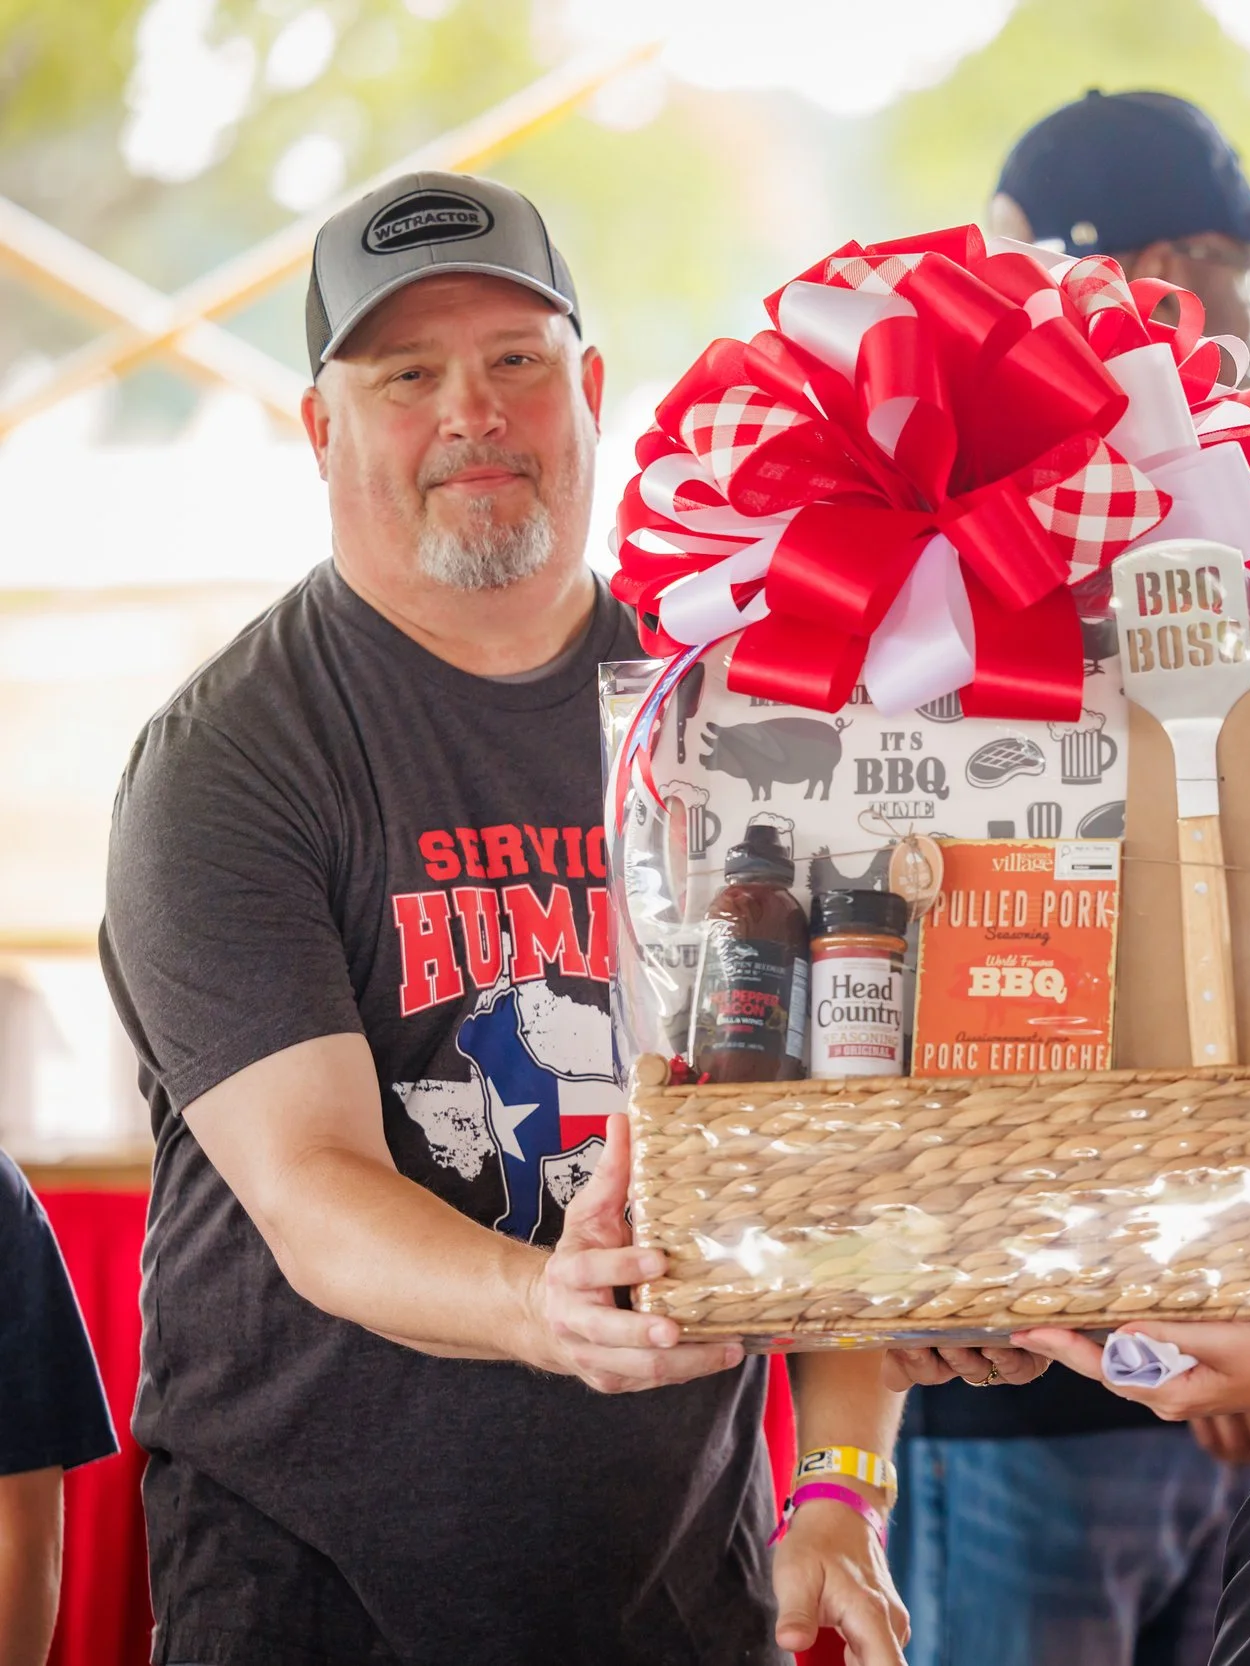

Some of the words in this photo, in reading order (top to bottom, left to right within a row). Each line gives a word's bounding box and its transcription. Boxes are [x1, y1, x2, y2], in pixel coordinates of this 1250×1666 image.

[374, 212, 480, 241] WCTRACTOR
[1135, 566, 1223, 617] BBQ
[1126, 620, 1244, 674] BOSS
[853, 756, 950, 800] BBQ
[992, 853, 1053, 873] village
[932, 889, 1028, 928] PULLED
[1042, 889, 1109, 928] PORK
[984, 926, 1051, 946] Seasoning
[832, 975, 892, 1001] Head
[968, 967, 1068, 1004] BBQ
[818, 1000, 901, 1031] Country
[824, 1033, 899, 1046] SEASONING
[924, 1043, 979, 1070] PORC
